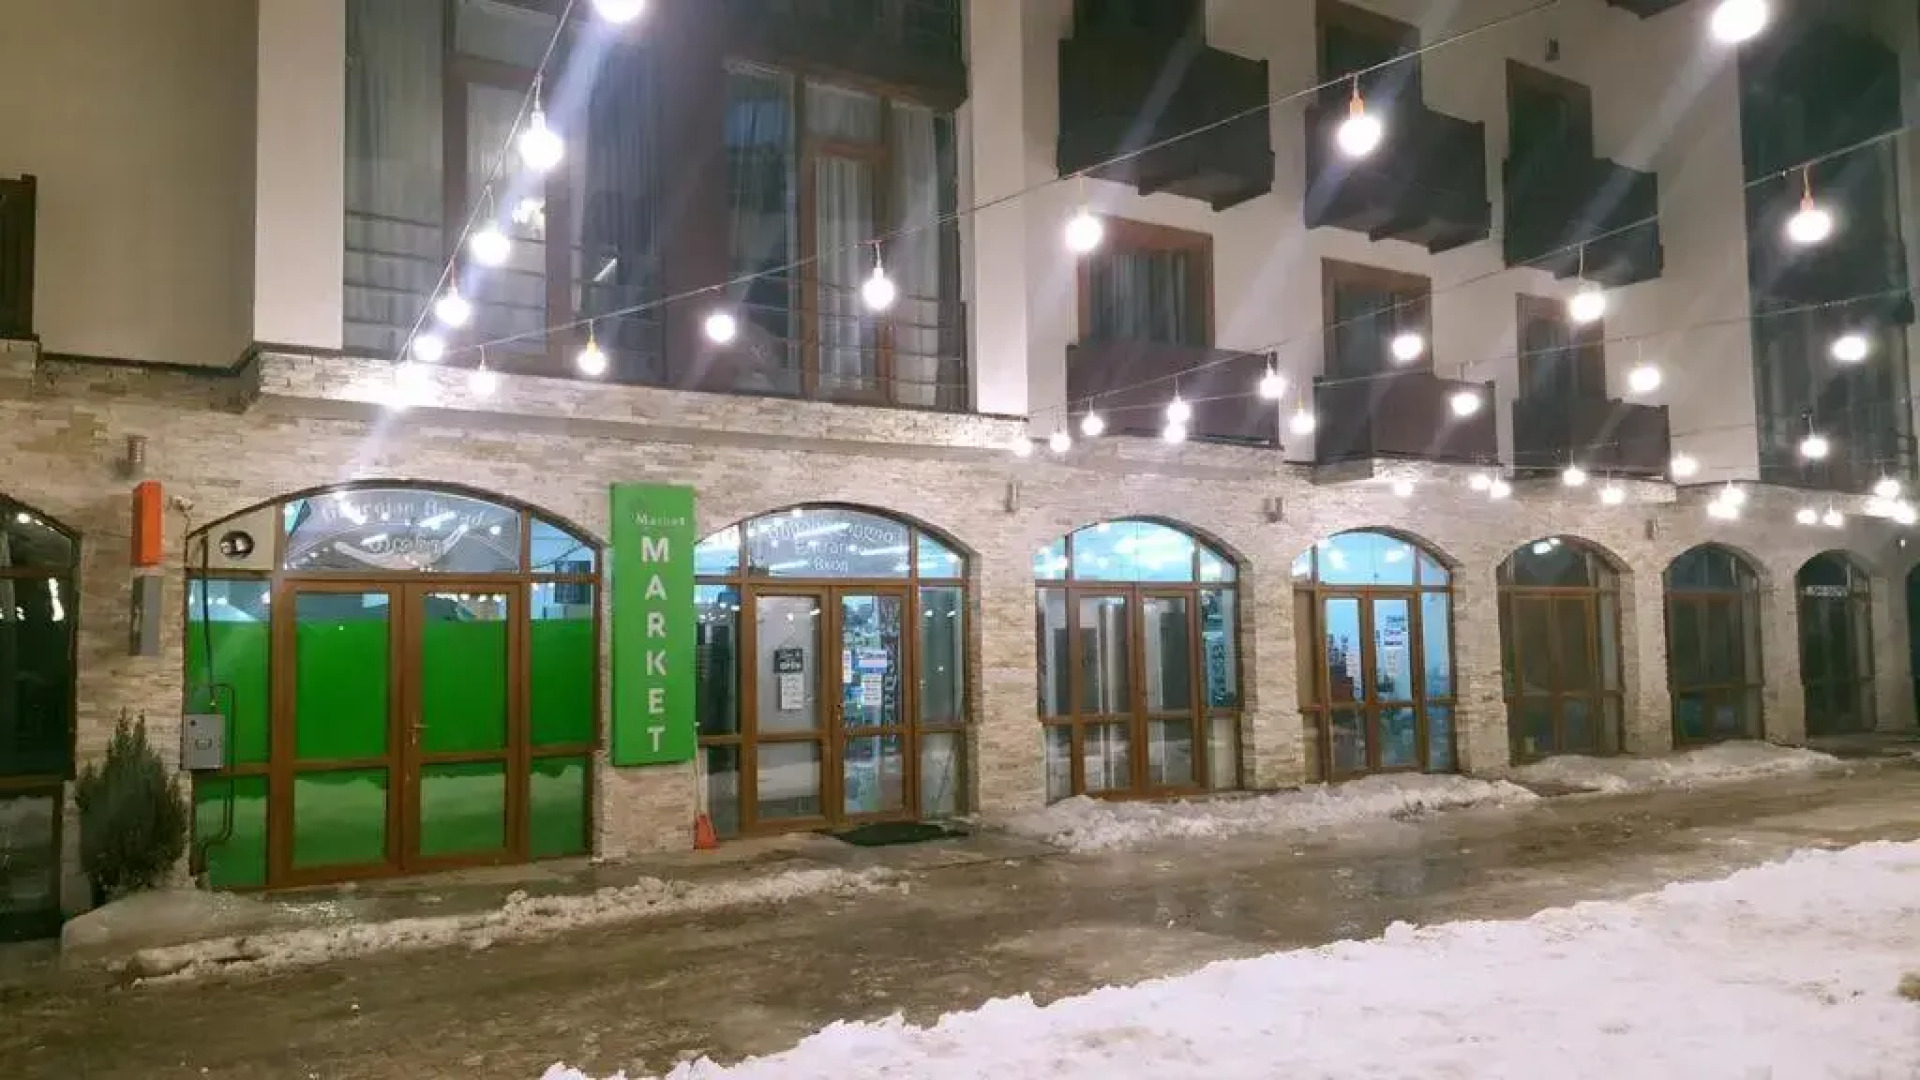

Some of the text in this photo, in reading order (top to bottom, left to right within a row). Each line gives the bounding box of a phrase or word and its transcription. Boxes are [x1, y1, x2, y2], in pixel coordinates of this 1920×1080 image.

[321, 496, 415, 519] Gergian
[794, 540, 867, 556] Entrane
[813, 557, 848, 573] Вход
[641, 535, 669, 753] MARKET
